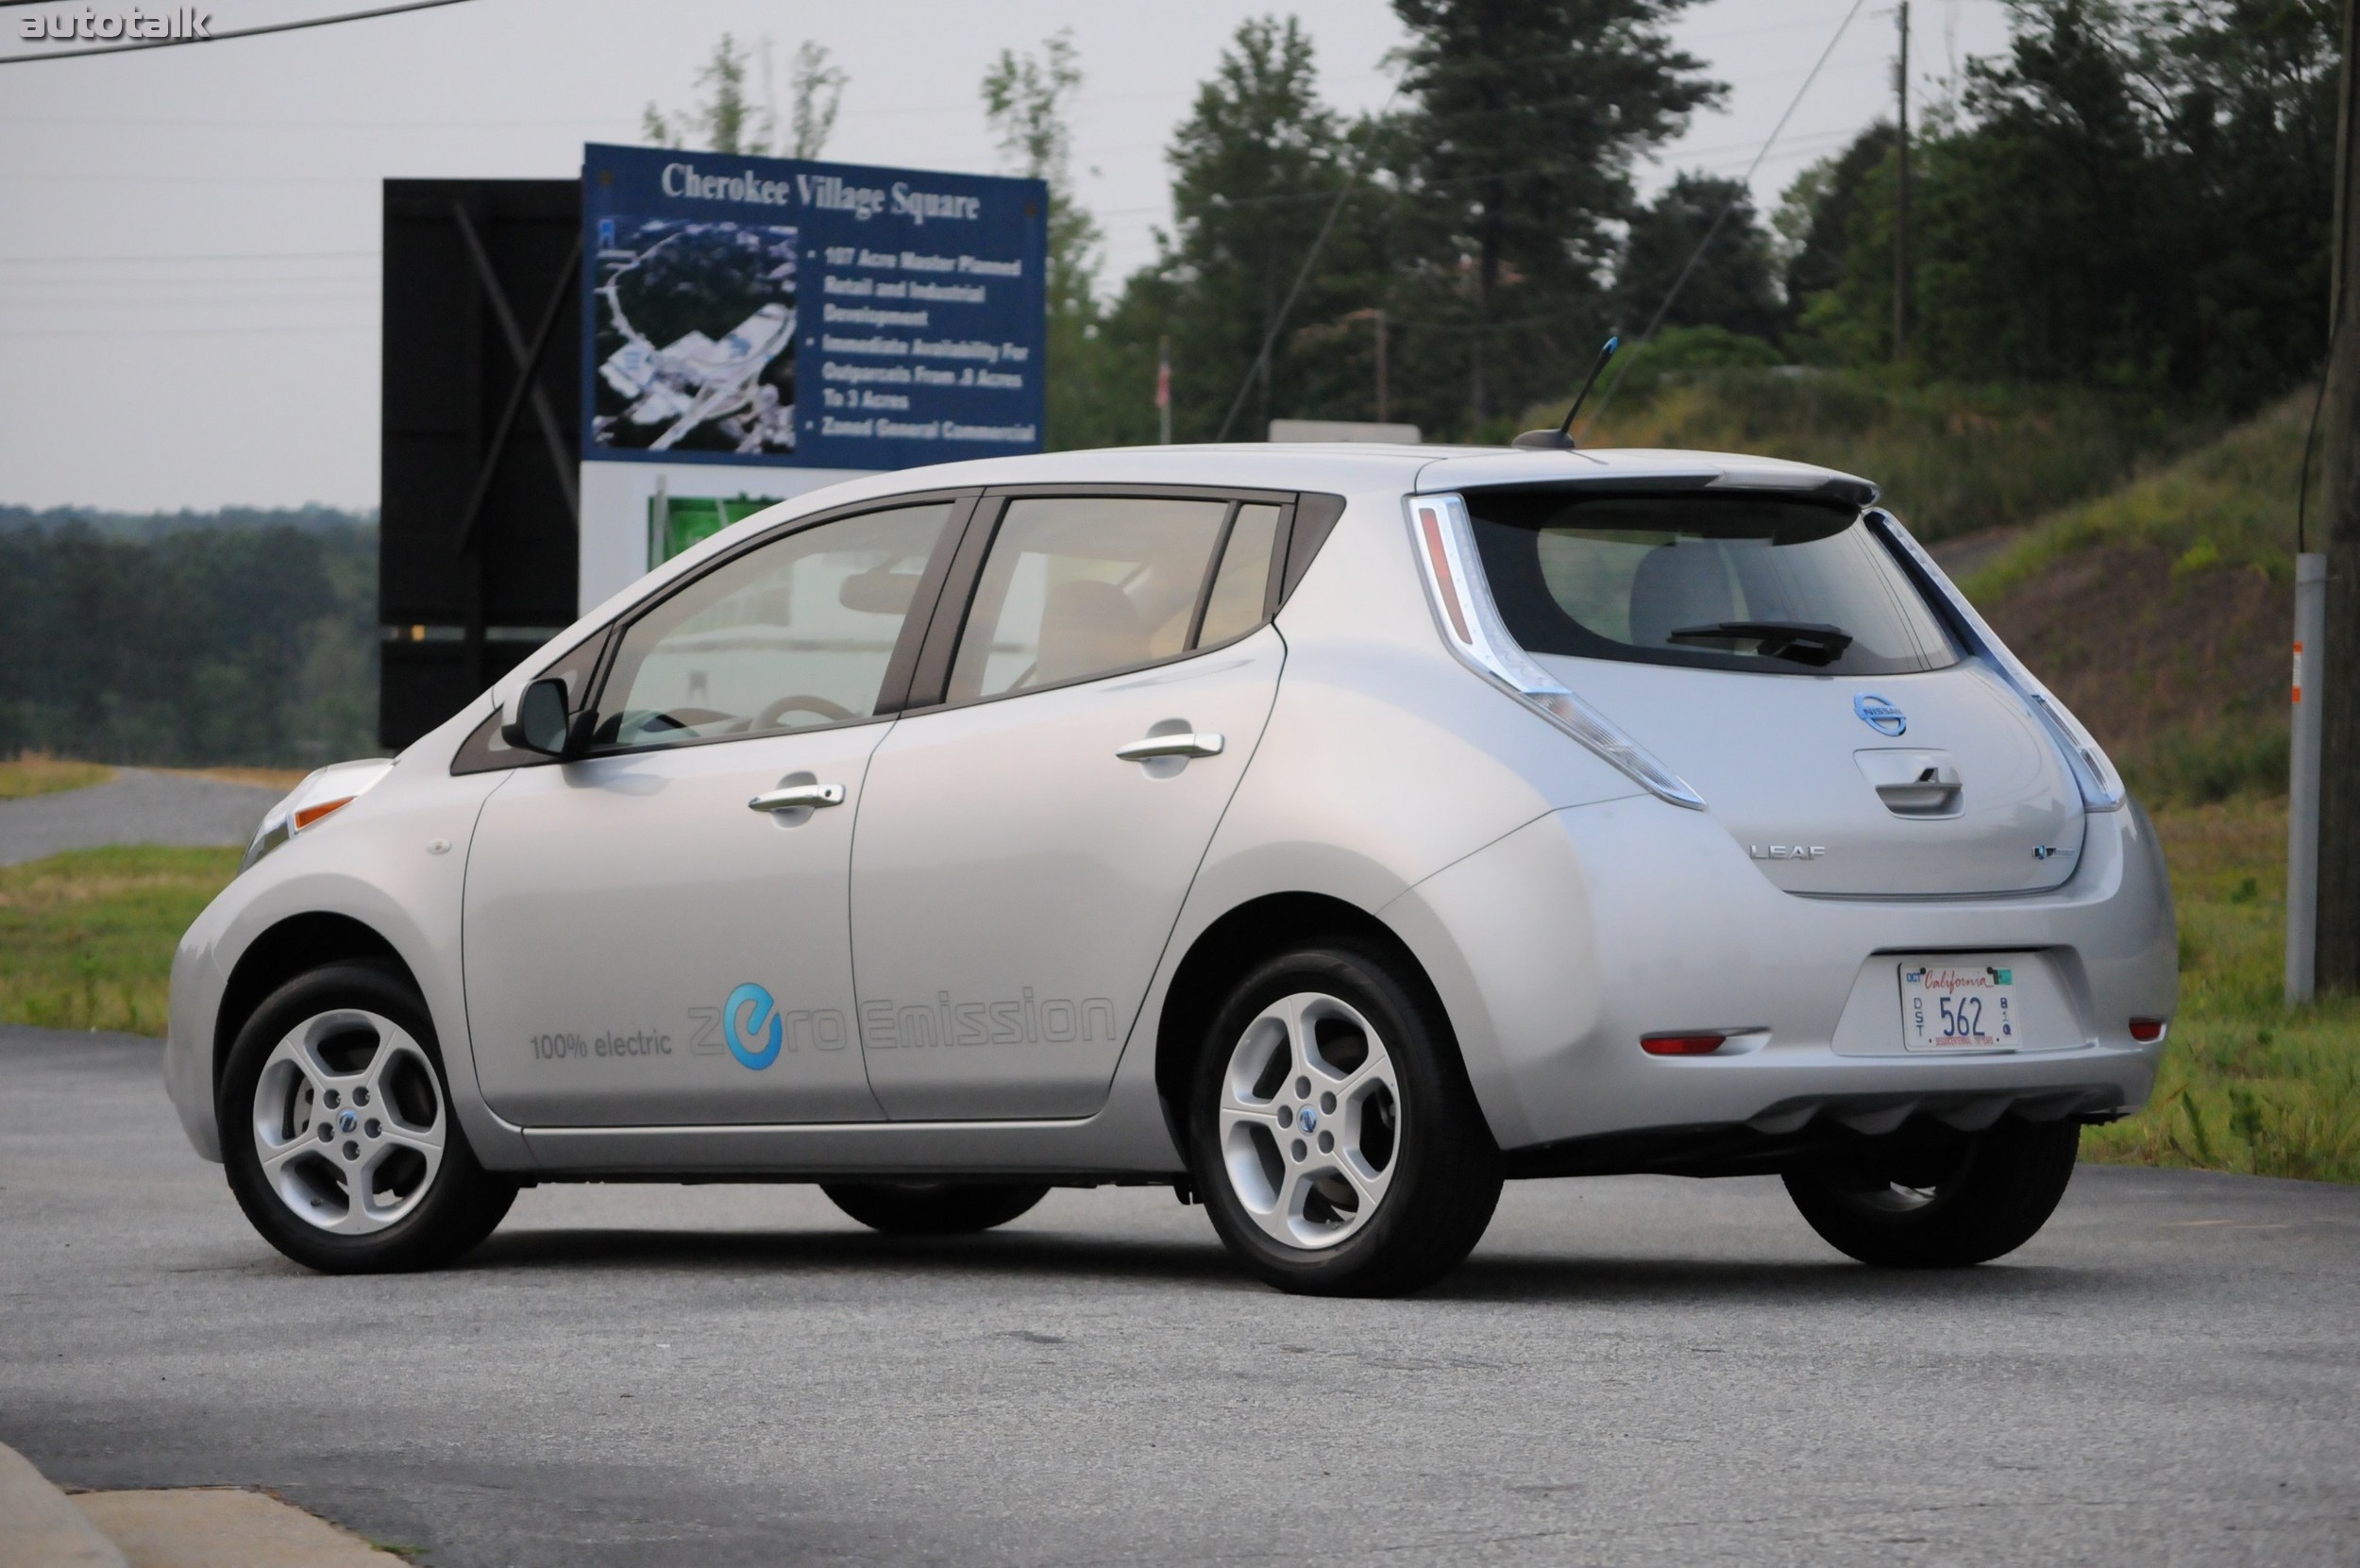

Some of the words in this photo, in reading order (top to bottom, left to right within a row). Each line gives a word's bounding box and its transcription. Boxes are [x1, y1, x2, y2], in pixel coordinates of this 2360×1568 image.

[662, 162, 790, 205] Cherokee
[797, 174, 885, 220] Village
[890, 181, 981, 225] Square
[823, 388, 844, 407] To
[1863, 707, 1903, 716] NISSAN
[1749, 844, 1826, 861] LEAF
[1924, 969, 1994, 995] California
[687, 982, 848, 1071] zero
[859, 986, 1116, 1049] Emission
[1940, 996, 1986, 1037] 562
[531, 1033, 587, 1059] 100%
[595, 1028, 673, 1058] electric
